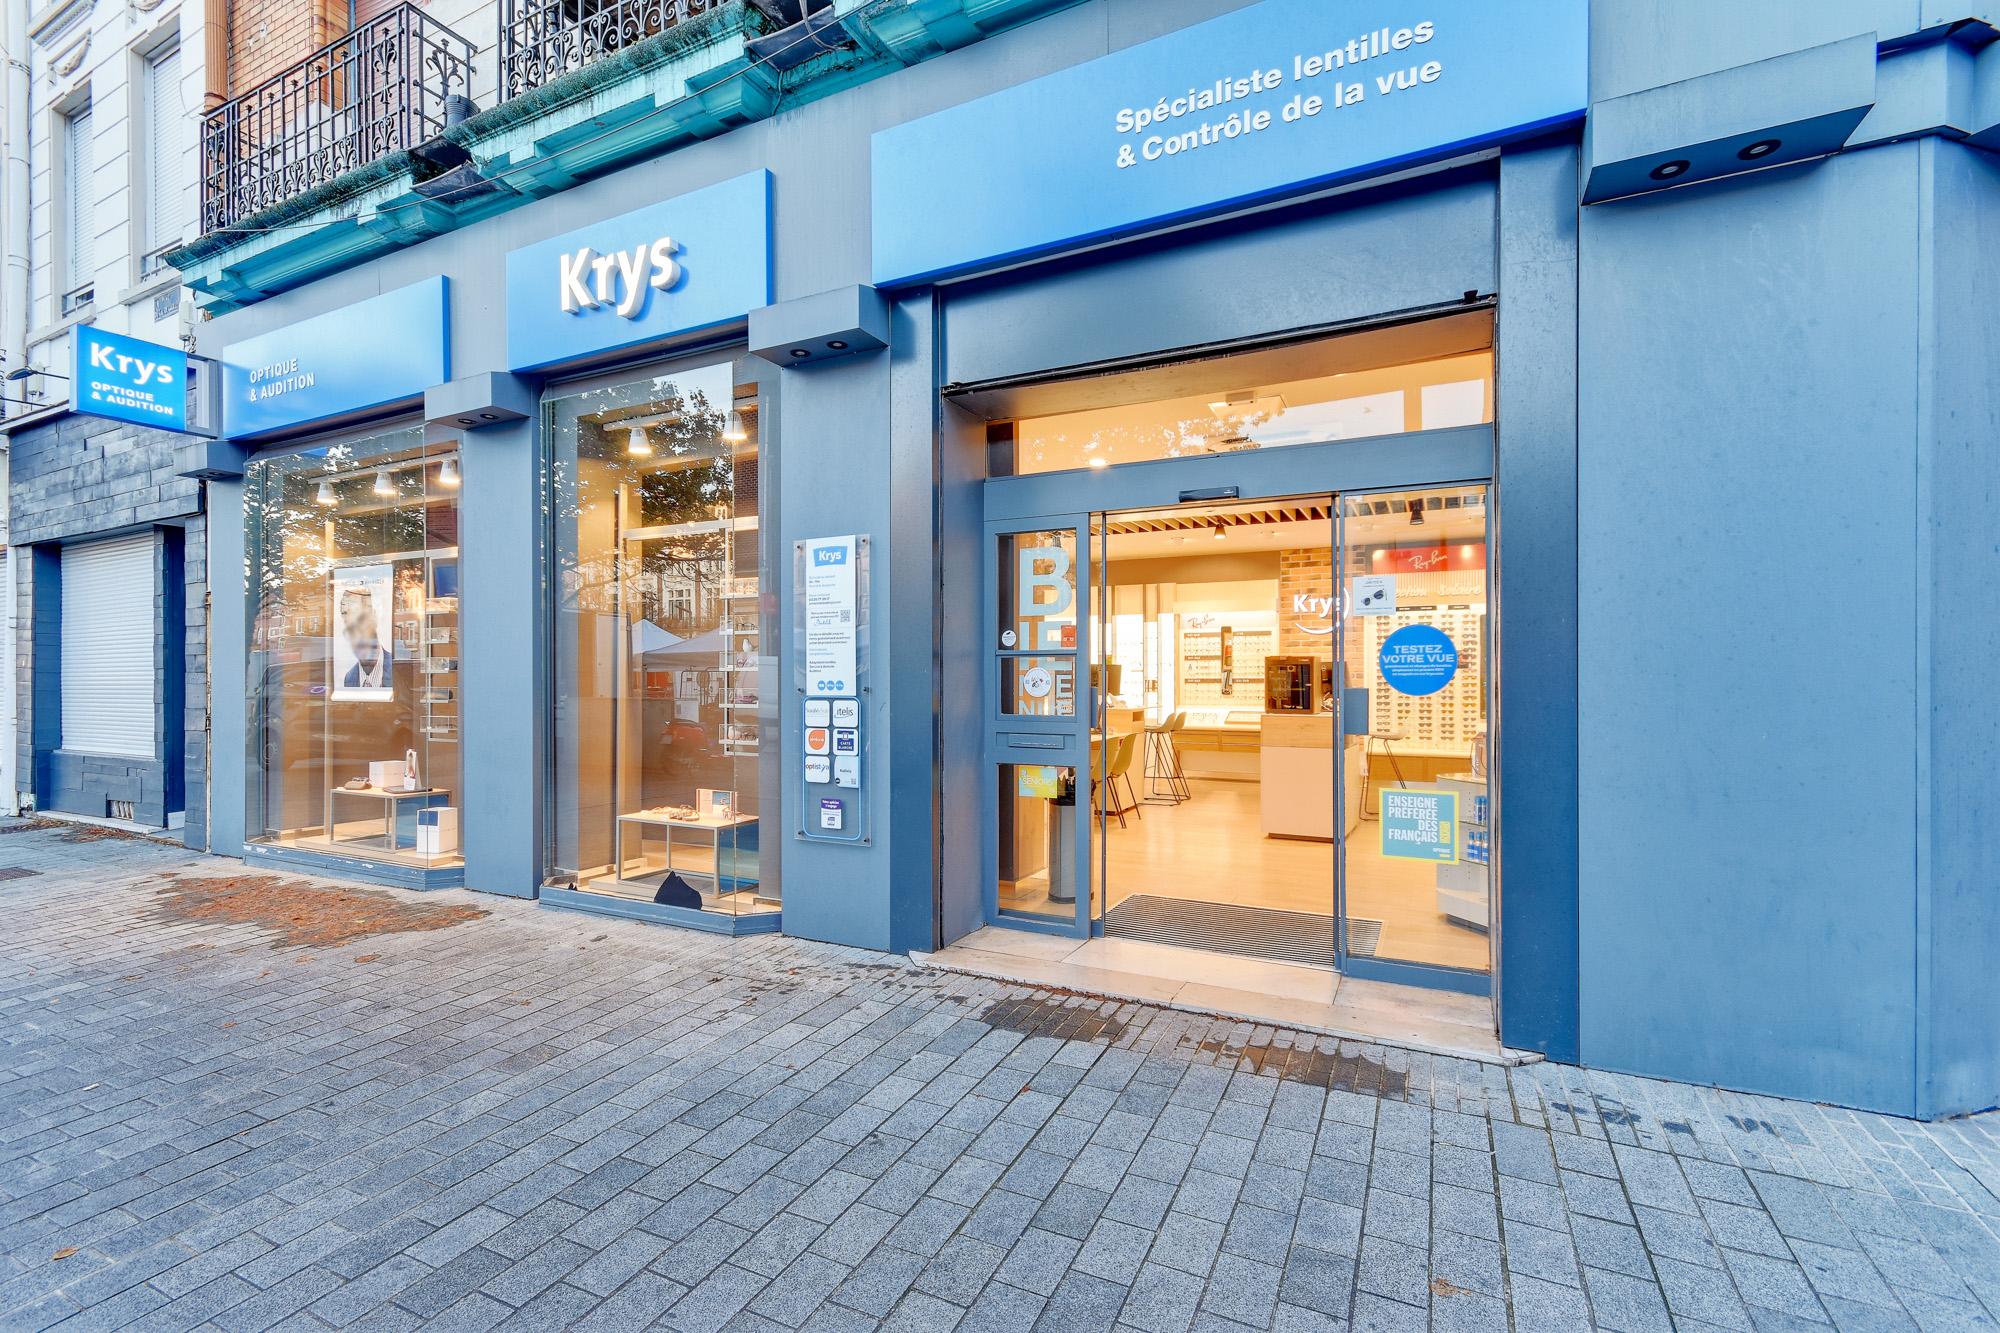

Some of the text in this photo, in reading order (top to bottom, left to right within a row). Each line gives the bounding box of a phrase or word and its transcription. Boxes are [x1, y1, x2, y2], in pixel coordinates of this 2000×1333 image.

[1116, 20, 1435, 133] Spécialiste lentilles
[1116, 60, 1442, 169] & Contrôle de la vue
[559, 236, 682, 320] Krys
[90, 342, 174, 385] Krys
[250, 358, 298, 383] OPTIQUE
[91, 381, 154, 402] OPTIQUE
[250, 372, 315, 402] & AUDITION
[91, 391, 174, 416] & AUDITION
[818, 550, 842, 563] Krys
[1019, 546, 1072, 616] B
[1293, 594, 1341, 618] Kry
[1382, 653, 1455, 663] VOTRE VUE
[1393, 645, 1443, 654] TESTEZ
[1388, 795, 1438, 809] ENSEIGNE
[1388, 828, 1438, 845] FRANÇAIS
[1418, 820, 1438, 832] DES
